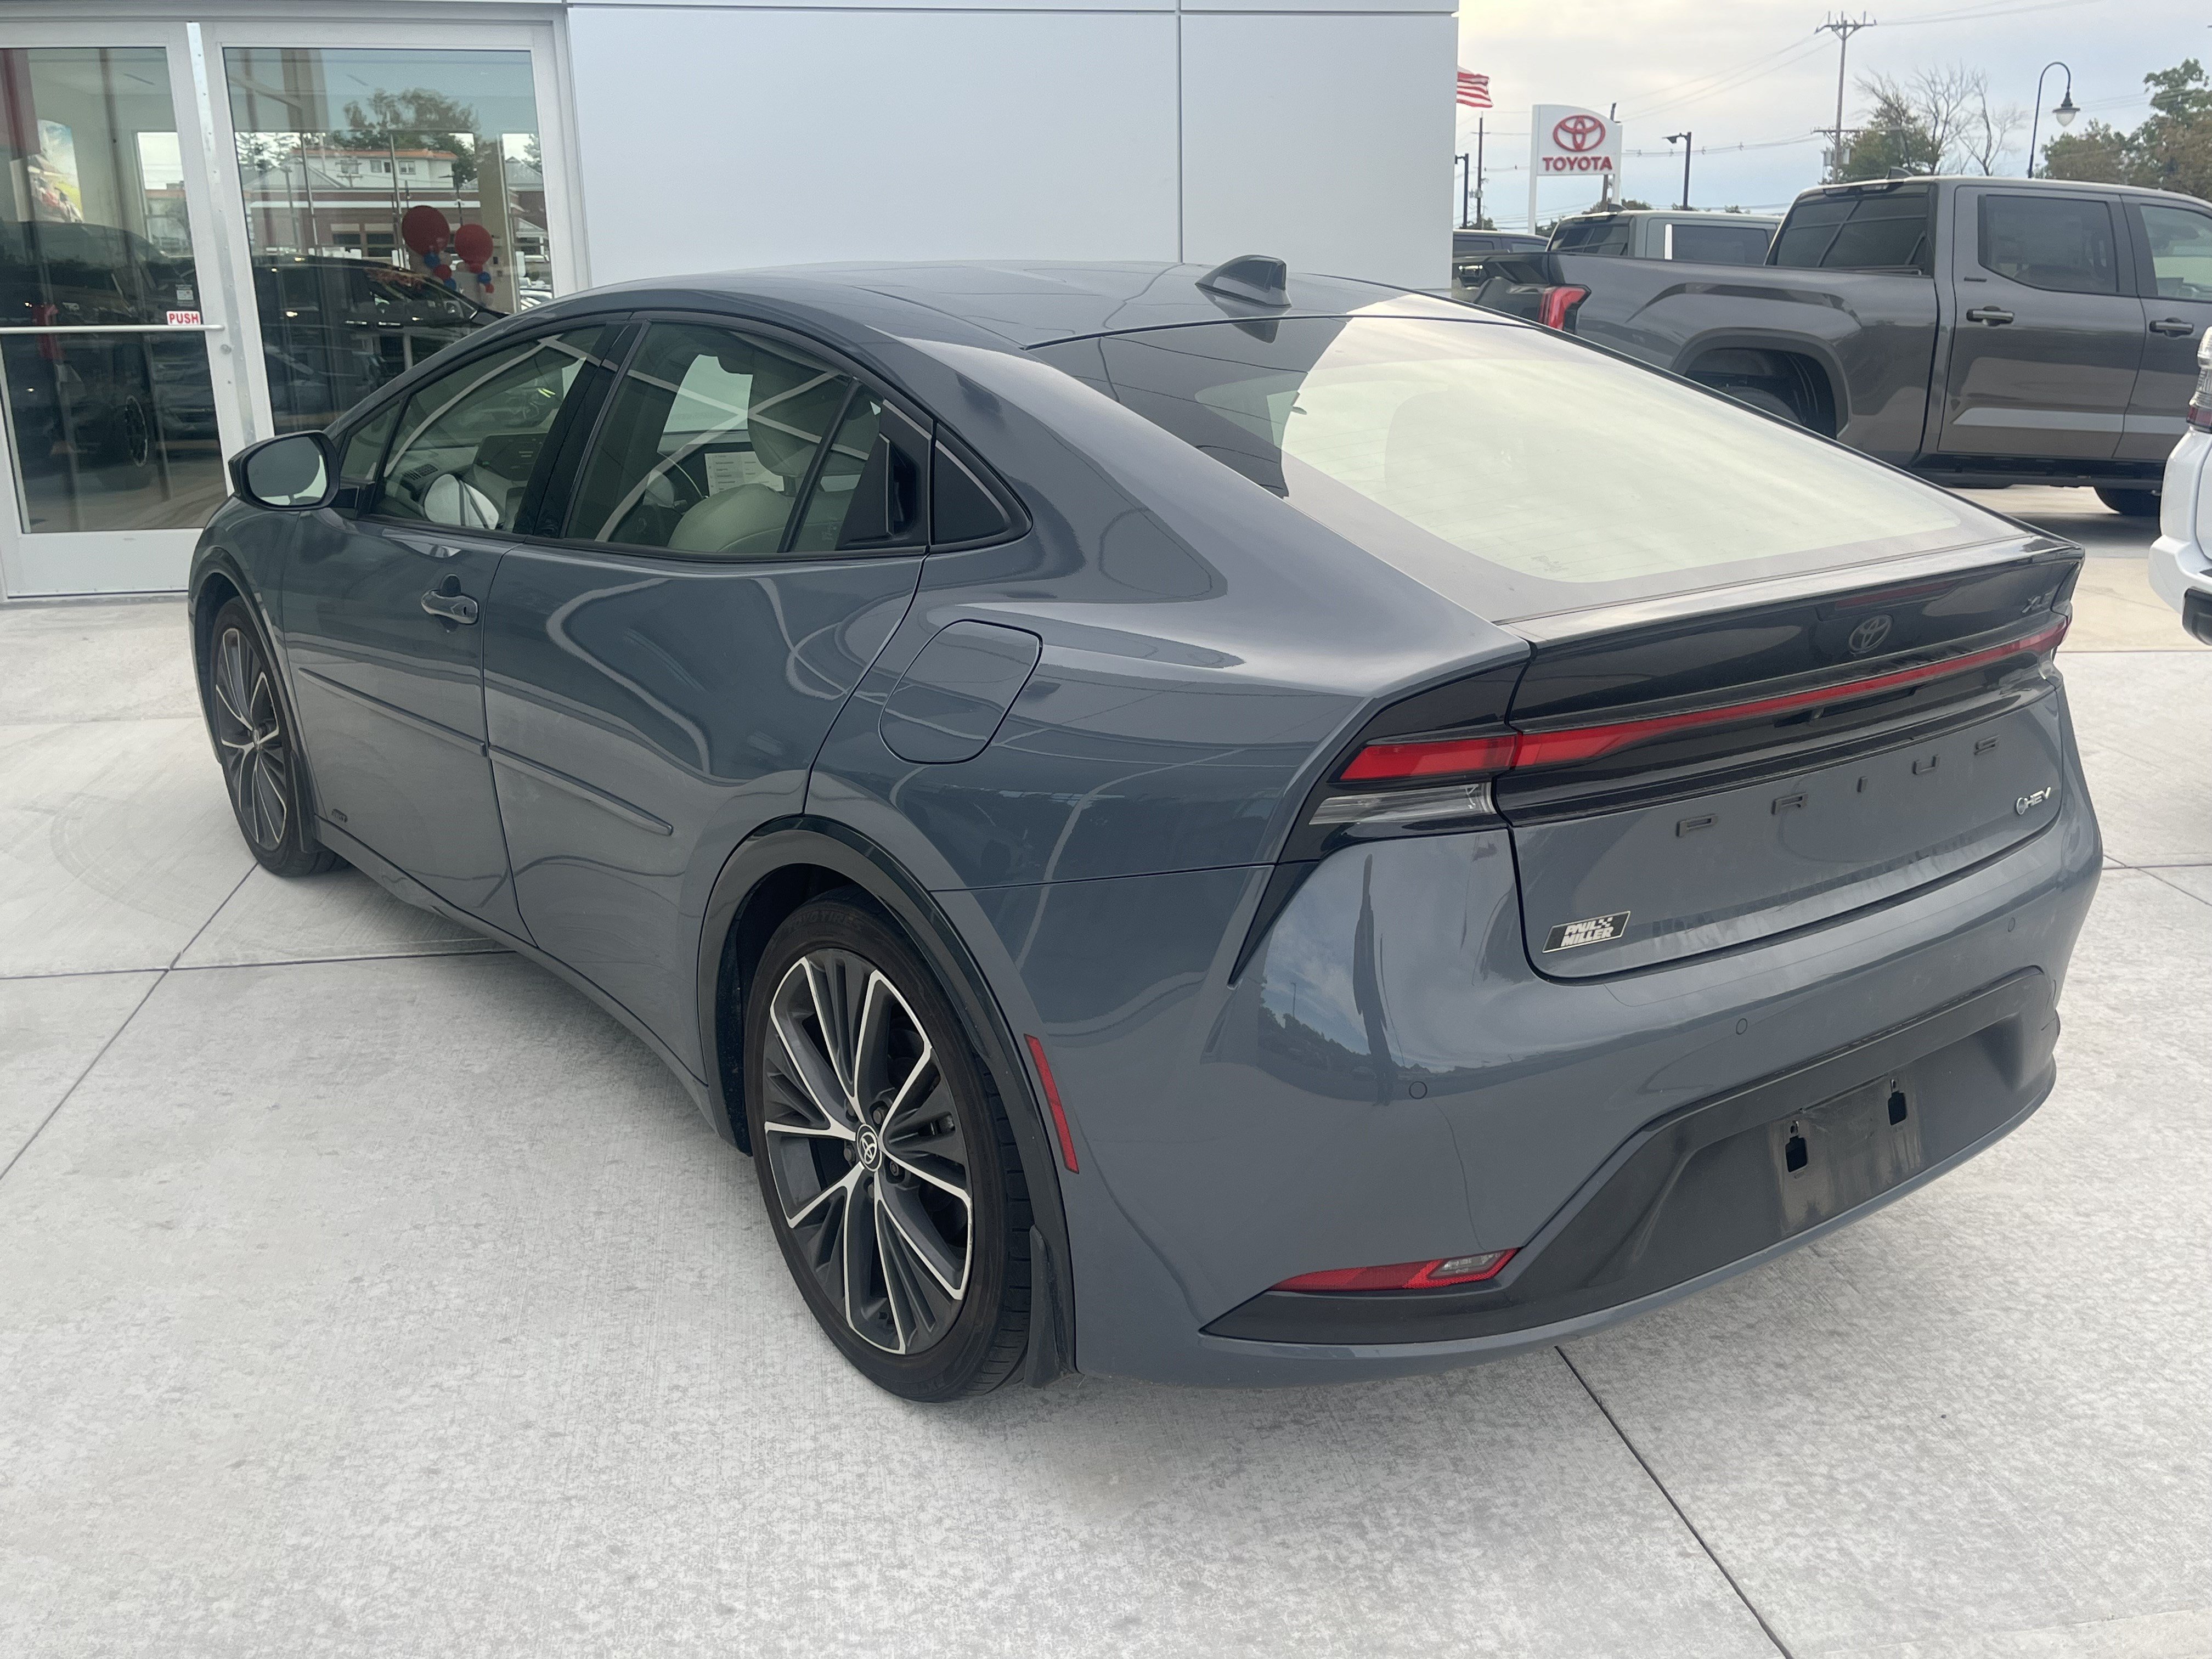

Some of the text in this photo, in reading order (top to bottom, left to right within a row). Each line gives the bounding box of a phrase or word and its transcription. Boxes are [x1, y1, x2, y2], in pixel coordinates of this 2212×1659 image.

[1542, 156, 1612, 171] TOYOTA
[169, 313, 199, 324] PUSH
[1676, 735, 2001, 837] PRIUS
[1565, 920, 1601, 935] PAUL
[1560, 926, 1614, 947] MILLER
